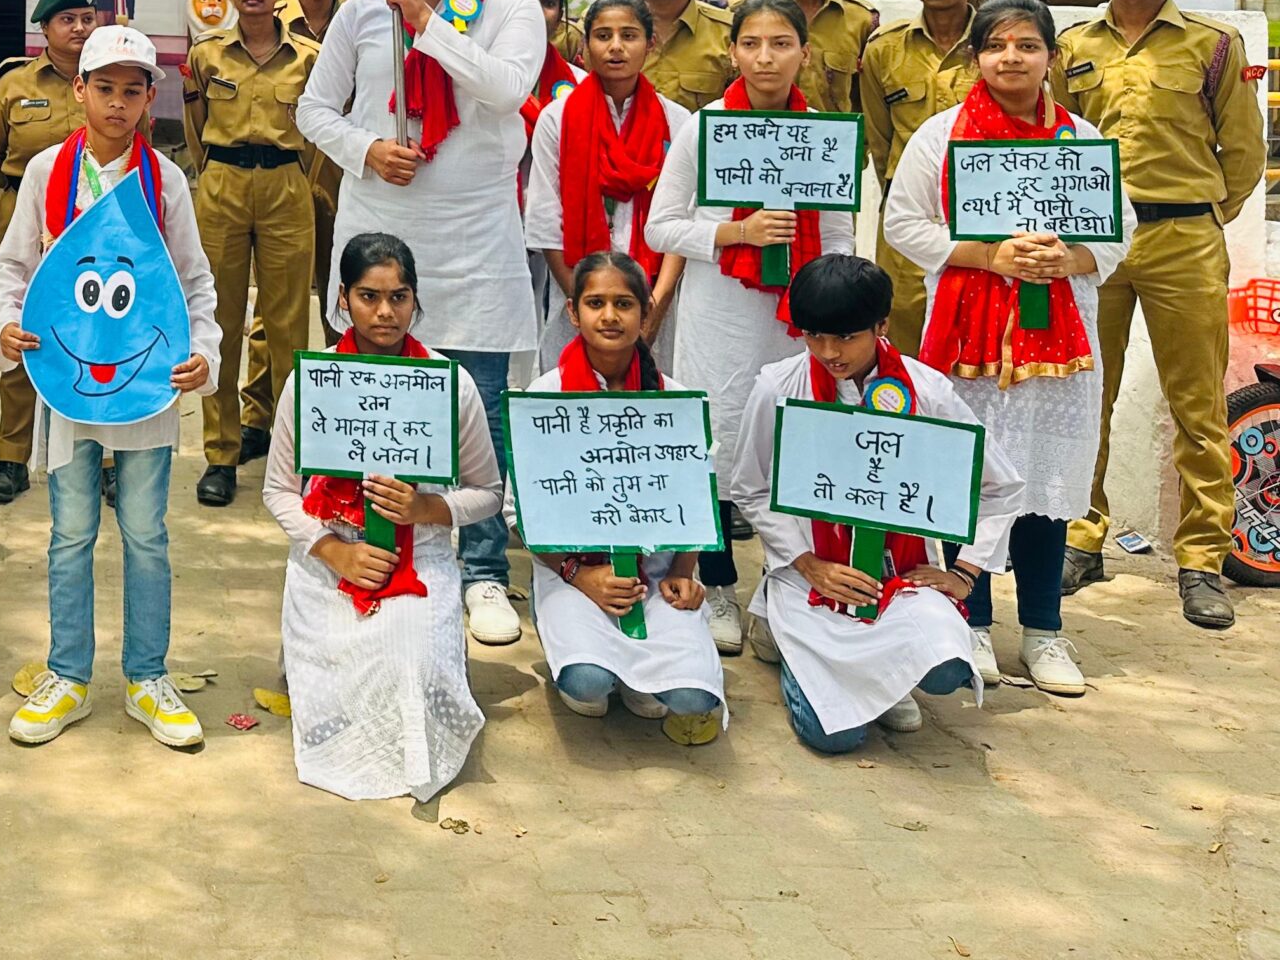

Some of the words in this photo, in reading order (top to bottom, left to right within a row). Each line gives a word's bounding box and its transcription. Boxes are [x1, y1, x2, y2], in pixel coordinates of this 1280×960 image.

[1247, 68, 1263, 79] NCC
[714, 124, 737, 143] हम
[743, 118, 783, 141] सबने
[787, 126, 813, 143] यह
[779, 146, 816, 161] ठाना
[822, 137, 838, 162] है
[961, 152, 994, 173] जल
[1000, 148, 1051, 172] संकट
[1055, 147, 1083, 171] को
[715, 159, 754, 185] पानी
[759, 158, 784, 184] को
[1018, 177, 1042, 199] दूर
[1051, 167, 1110, 193] भगाओ
[781, 182, 835, 198] बचाना
[962, 192, 1002, 216] व्यर्थ
[1007, 191, 1021, 215] में
[1034, 193, 1074, 216] पानी
[1016, 217, 1037, 232] ना
[308, 363, 343, 388] पानी
[349, 370, 376, 385] एक
[380, 369, 446, 391] अनमोल
[359, 395, 391, 411] रतन
[312, 407, 327, 434] ले
[334, 418, 379, 437] मानव
[384, 421, 403, 445] तू
[403, 421, 432, 438] कर
[532, 406, 570, 434] पानी
[578, 407, 592, 434] है
[597, 406, 646, 437] प्रकृति
[654, 413, 673, 427] का
[348, 439, 366, 462] ले
[580, 441, 651, 464] अनमोल
[856, 430, 904, 458] जल
[867, 458, 884, 483] है
[539, 470, 577, 495] पानी
[586, 468, 605, 491] को
[612, 476, 642, 502] तुम
[648, 474, 669, 490] ना
[813, 473, 835, 500] तो
[845, 487, 888, 510] कल
[591, 503, 621, 526] करो
